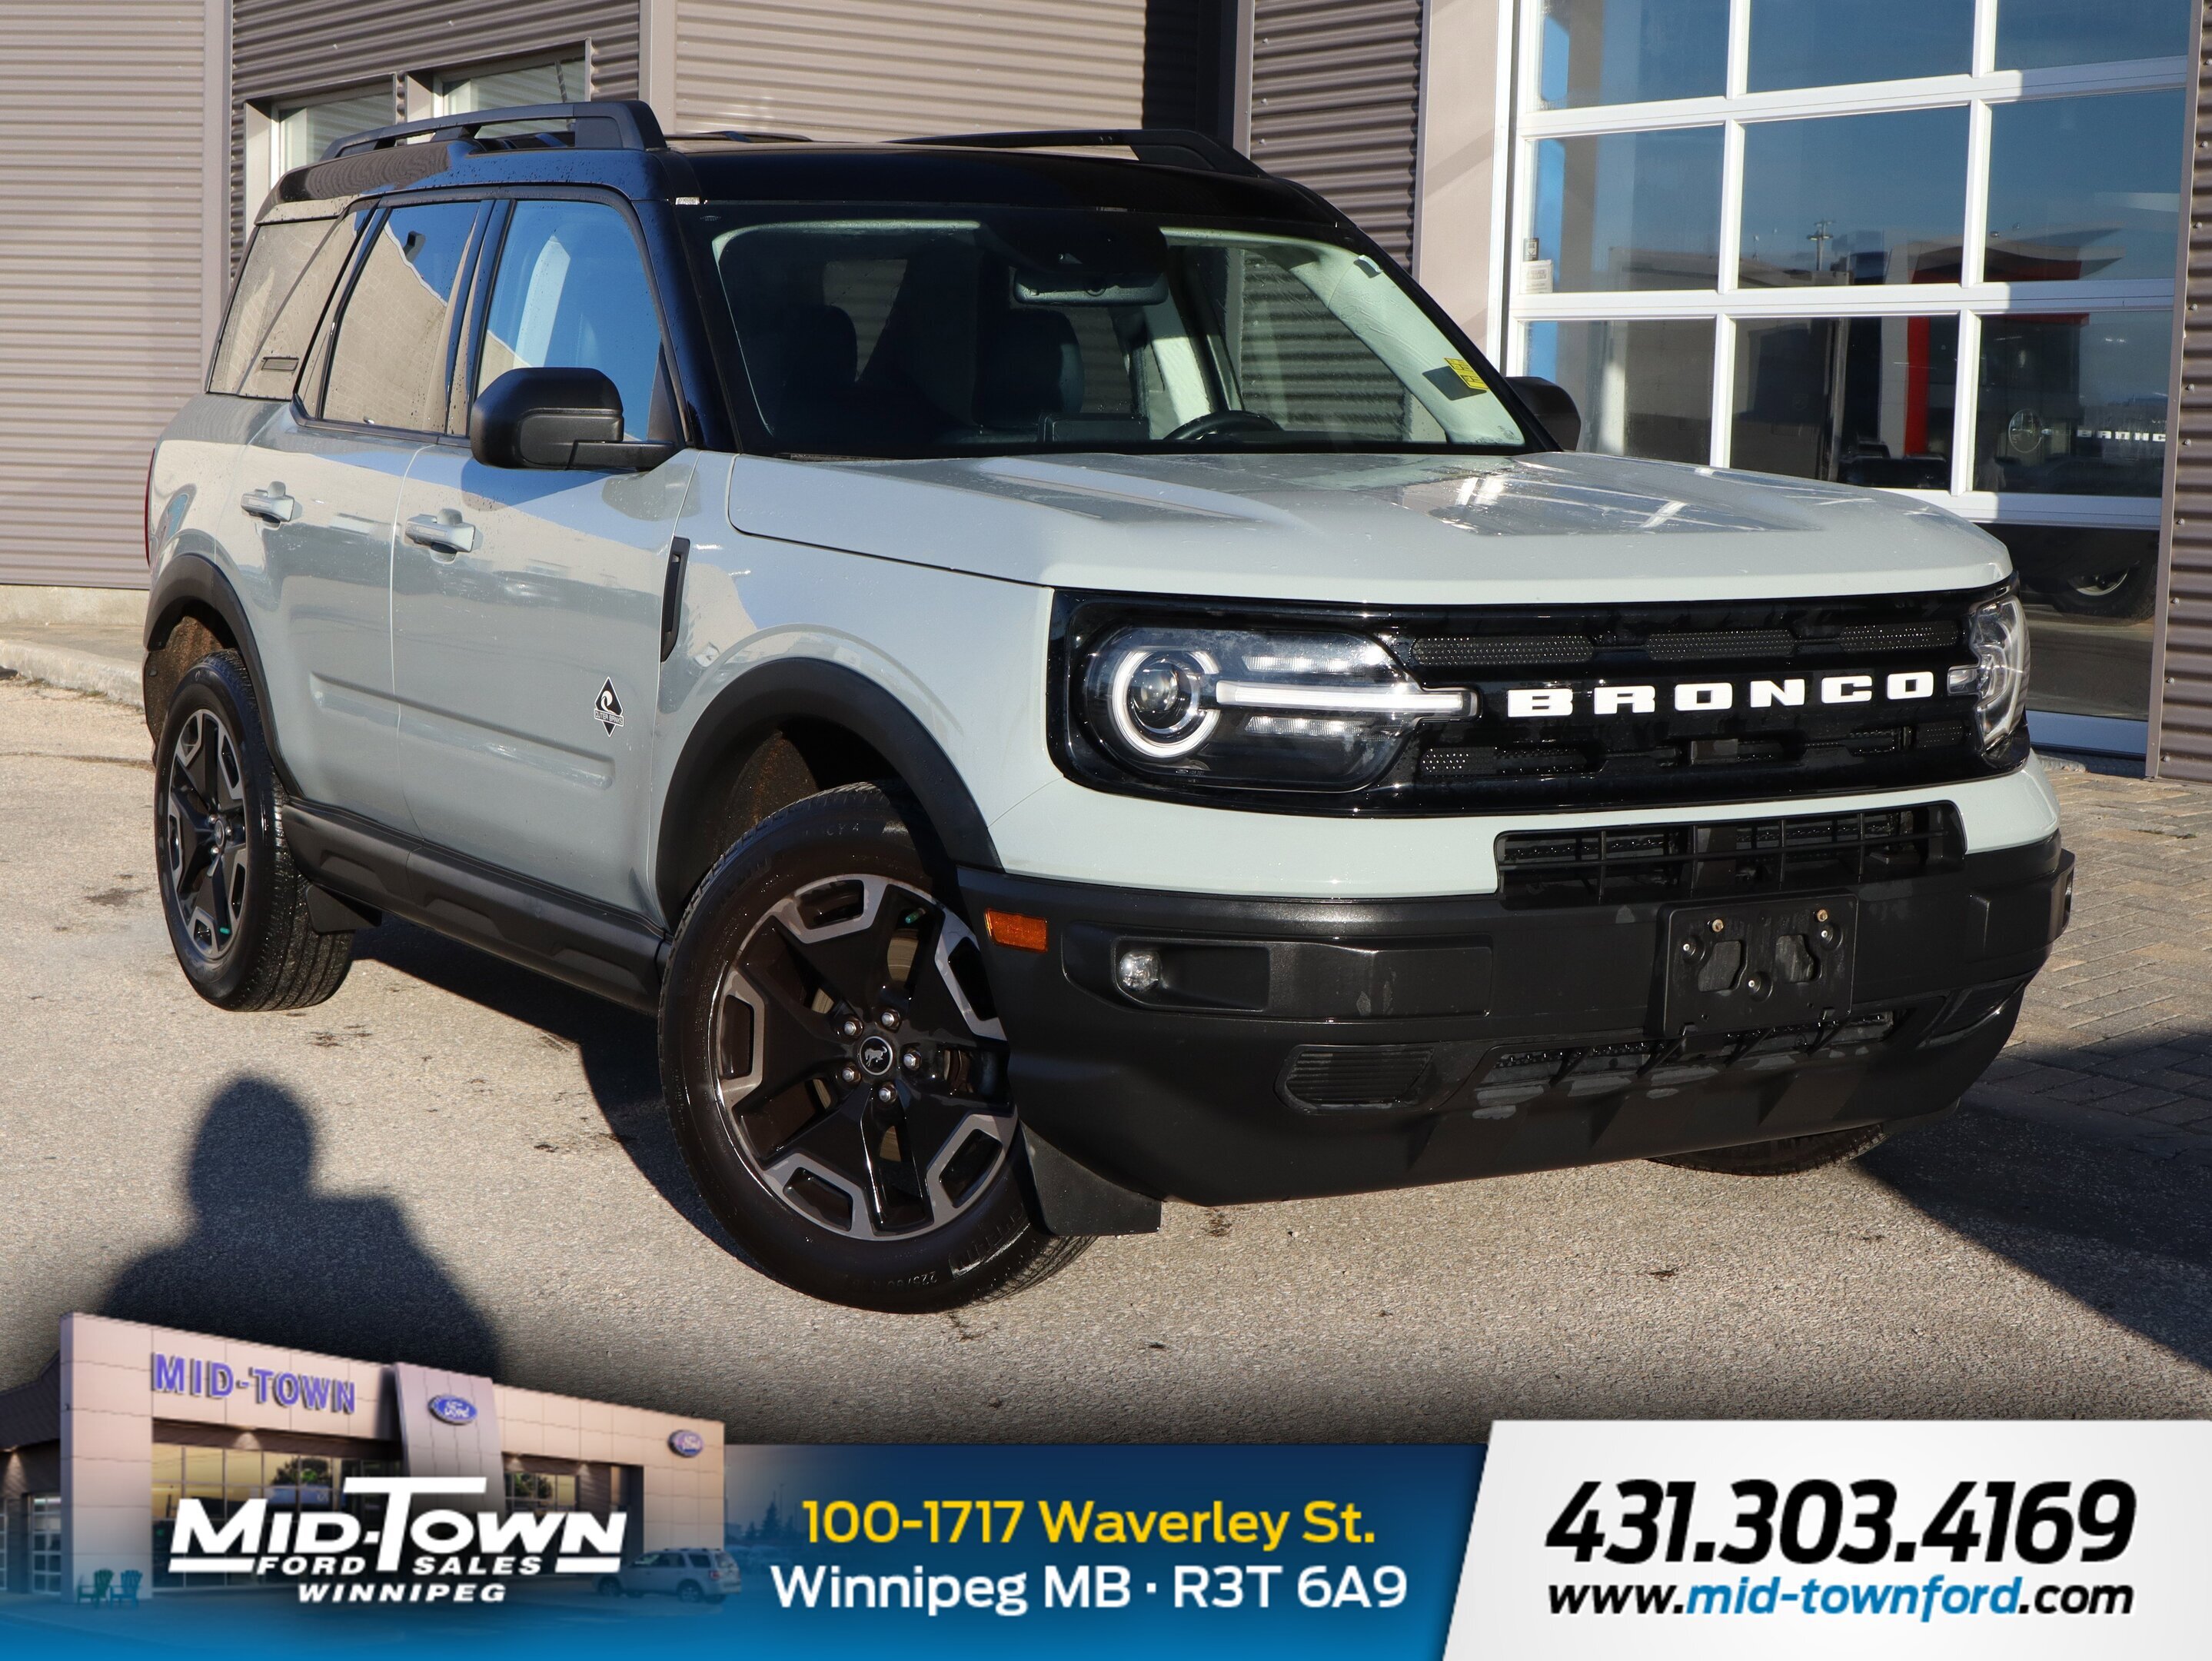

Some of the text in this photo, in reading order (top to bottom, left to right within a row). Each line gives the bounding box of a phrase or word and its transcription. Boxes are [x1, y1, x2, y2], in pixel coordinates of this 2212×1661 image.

[2077, 429, 2167, 442] BRONC
[1507, 671, 1934, 718] BRONCO
[595, 711, 623, 724] OUTER BANKS
